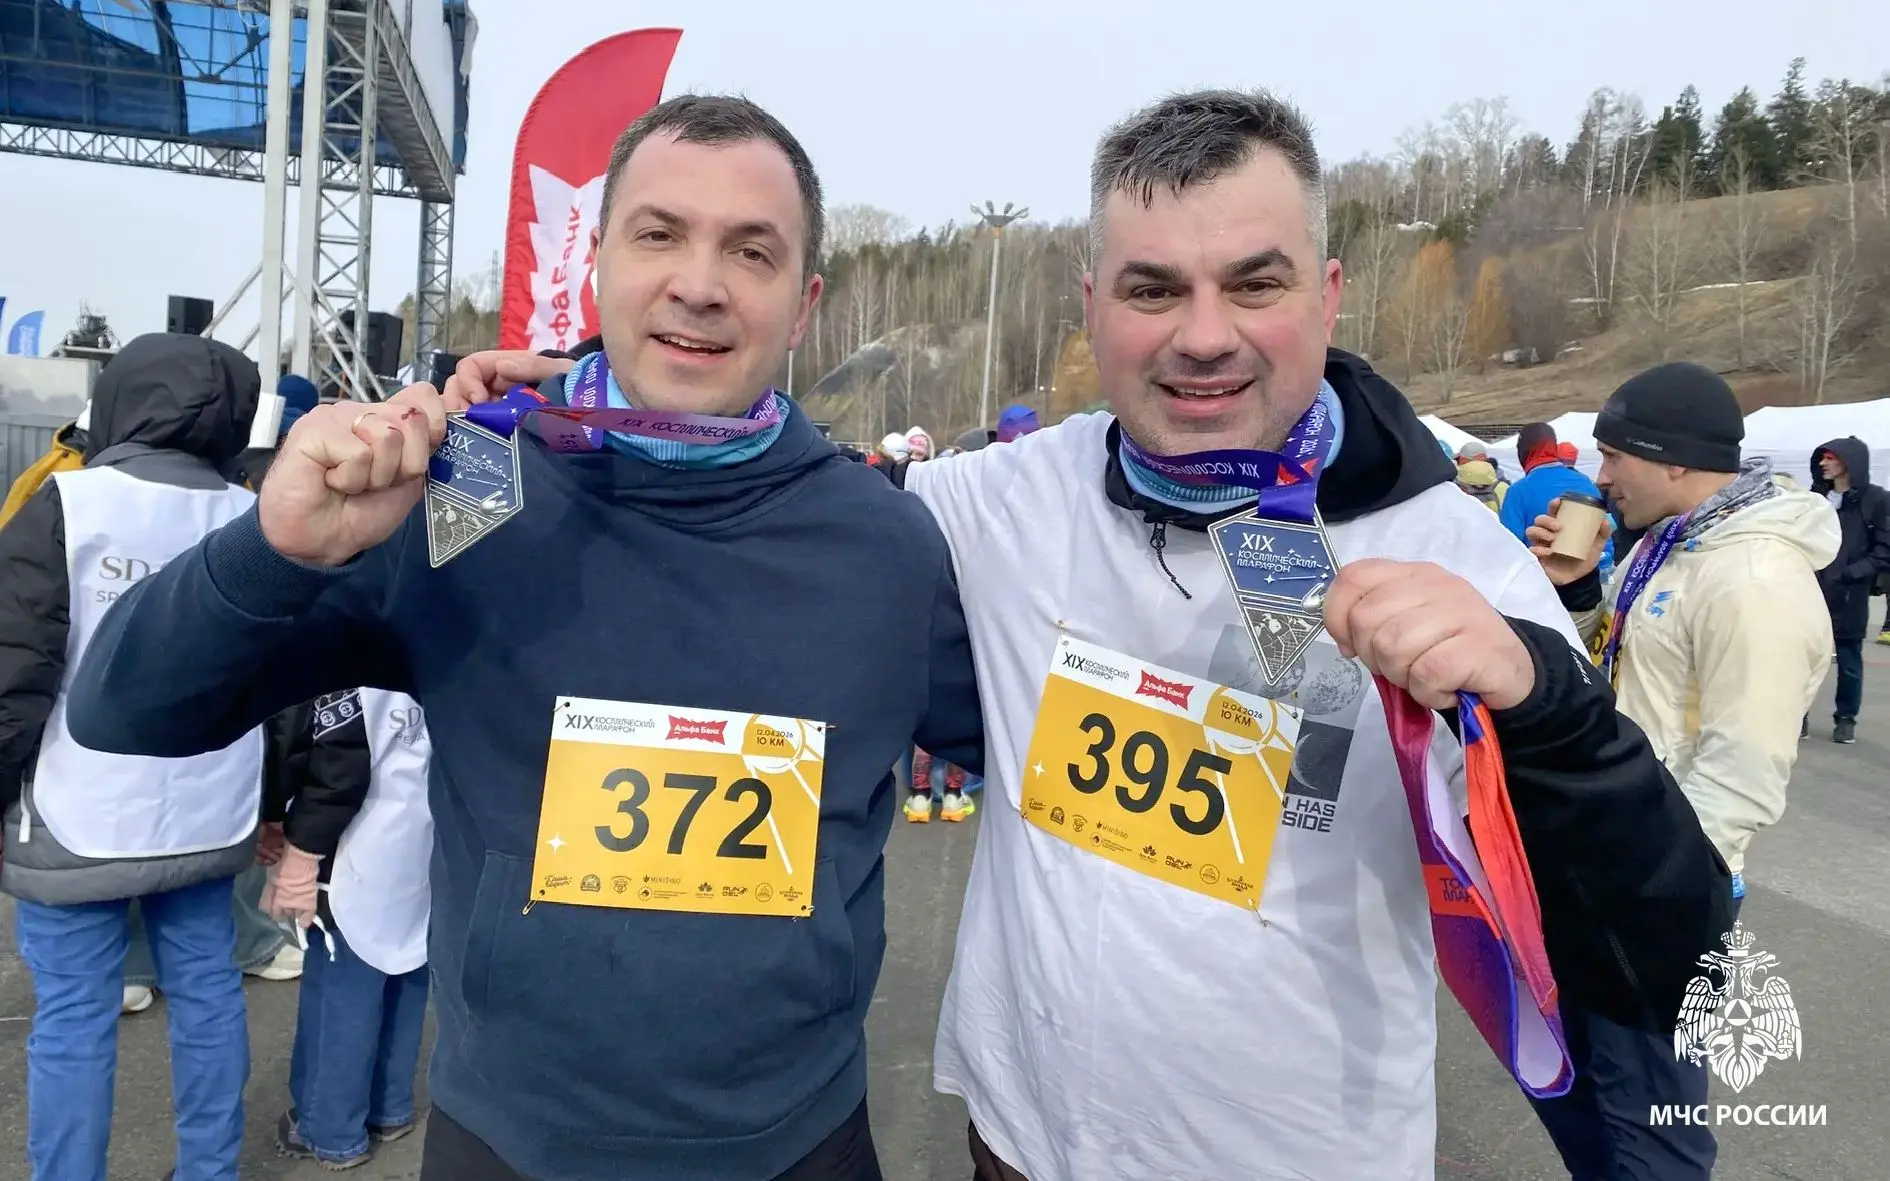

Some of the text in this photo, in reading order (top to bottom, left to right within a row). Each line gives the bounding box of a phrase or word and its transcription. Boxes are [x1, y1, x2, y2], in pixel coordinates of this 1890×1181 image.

[551, 203, 582, 284] Банк
[443, 429, 475, 453] XIX
[442, 445, 503, 476] ОСМИЧЕСКИЙ
[1238, 462, 1260, 479] XIX
[1240, 532, 1275, 552] XIX
[1062, 651, 1085, 671] XIX
[1143, 680, 1185, 699] Альфа Банк
[565, 714, 595, 730] XIX
[1221, 709, 1251, 727] 10 КМ
[674, 725, 720, 735] Альфа Банк
[756, 736, 784, 747] 10 КМ
[1067, 712, 1233, 836] 395
[594, 768, 773, 860] 372
[1296, 798, 1336, 817] HAS
[1282, 810, 1333, 833] SIDE
